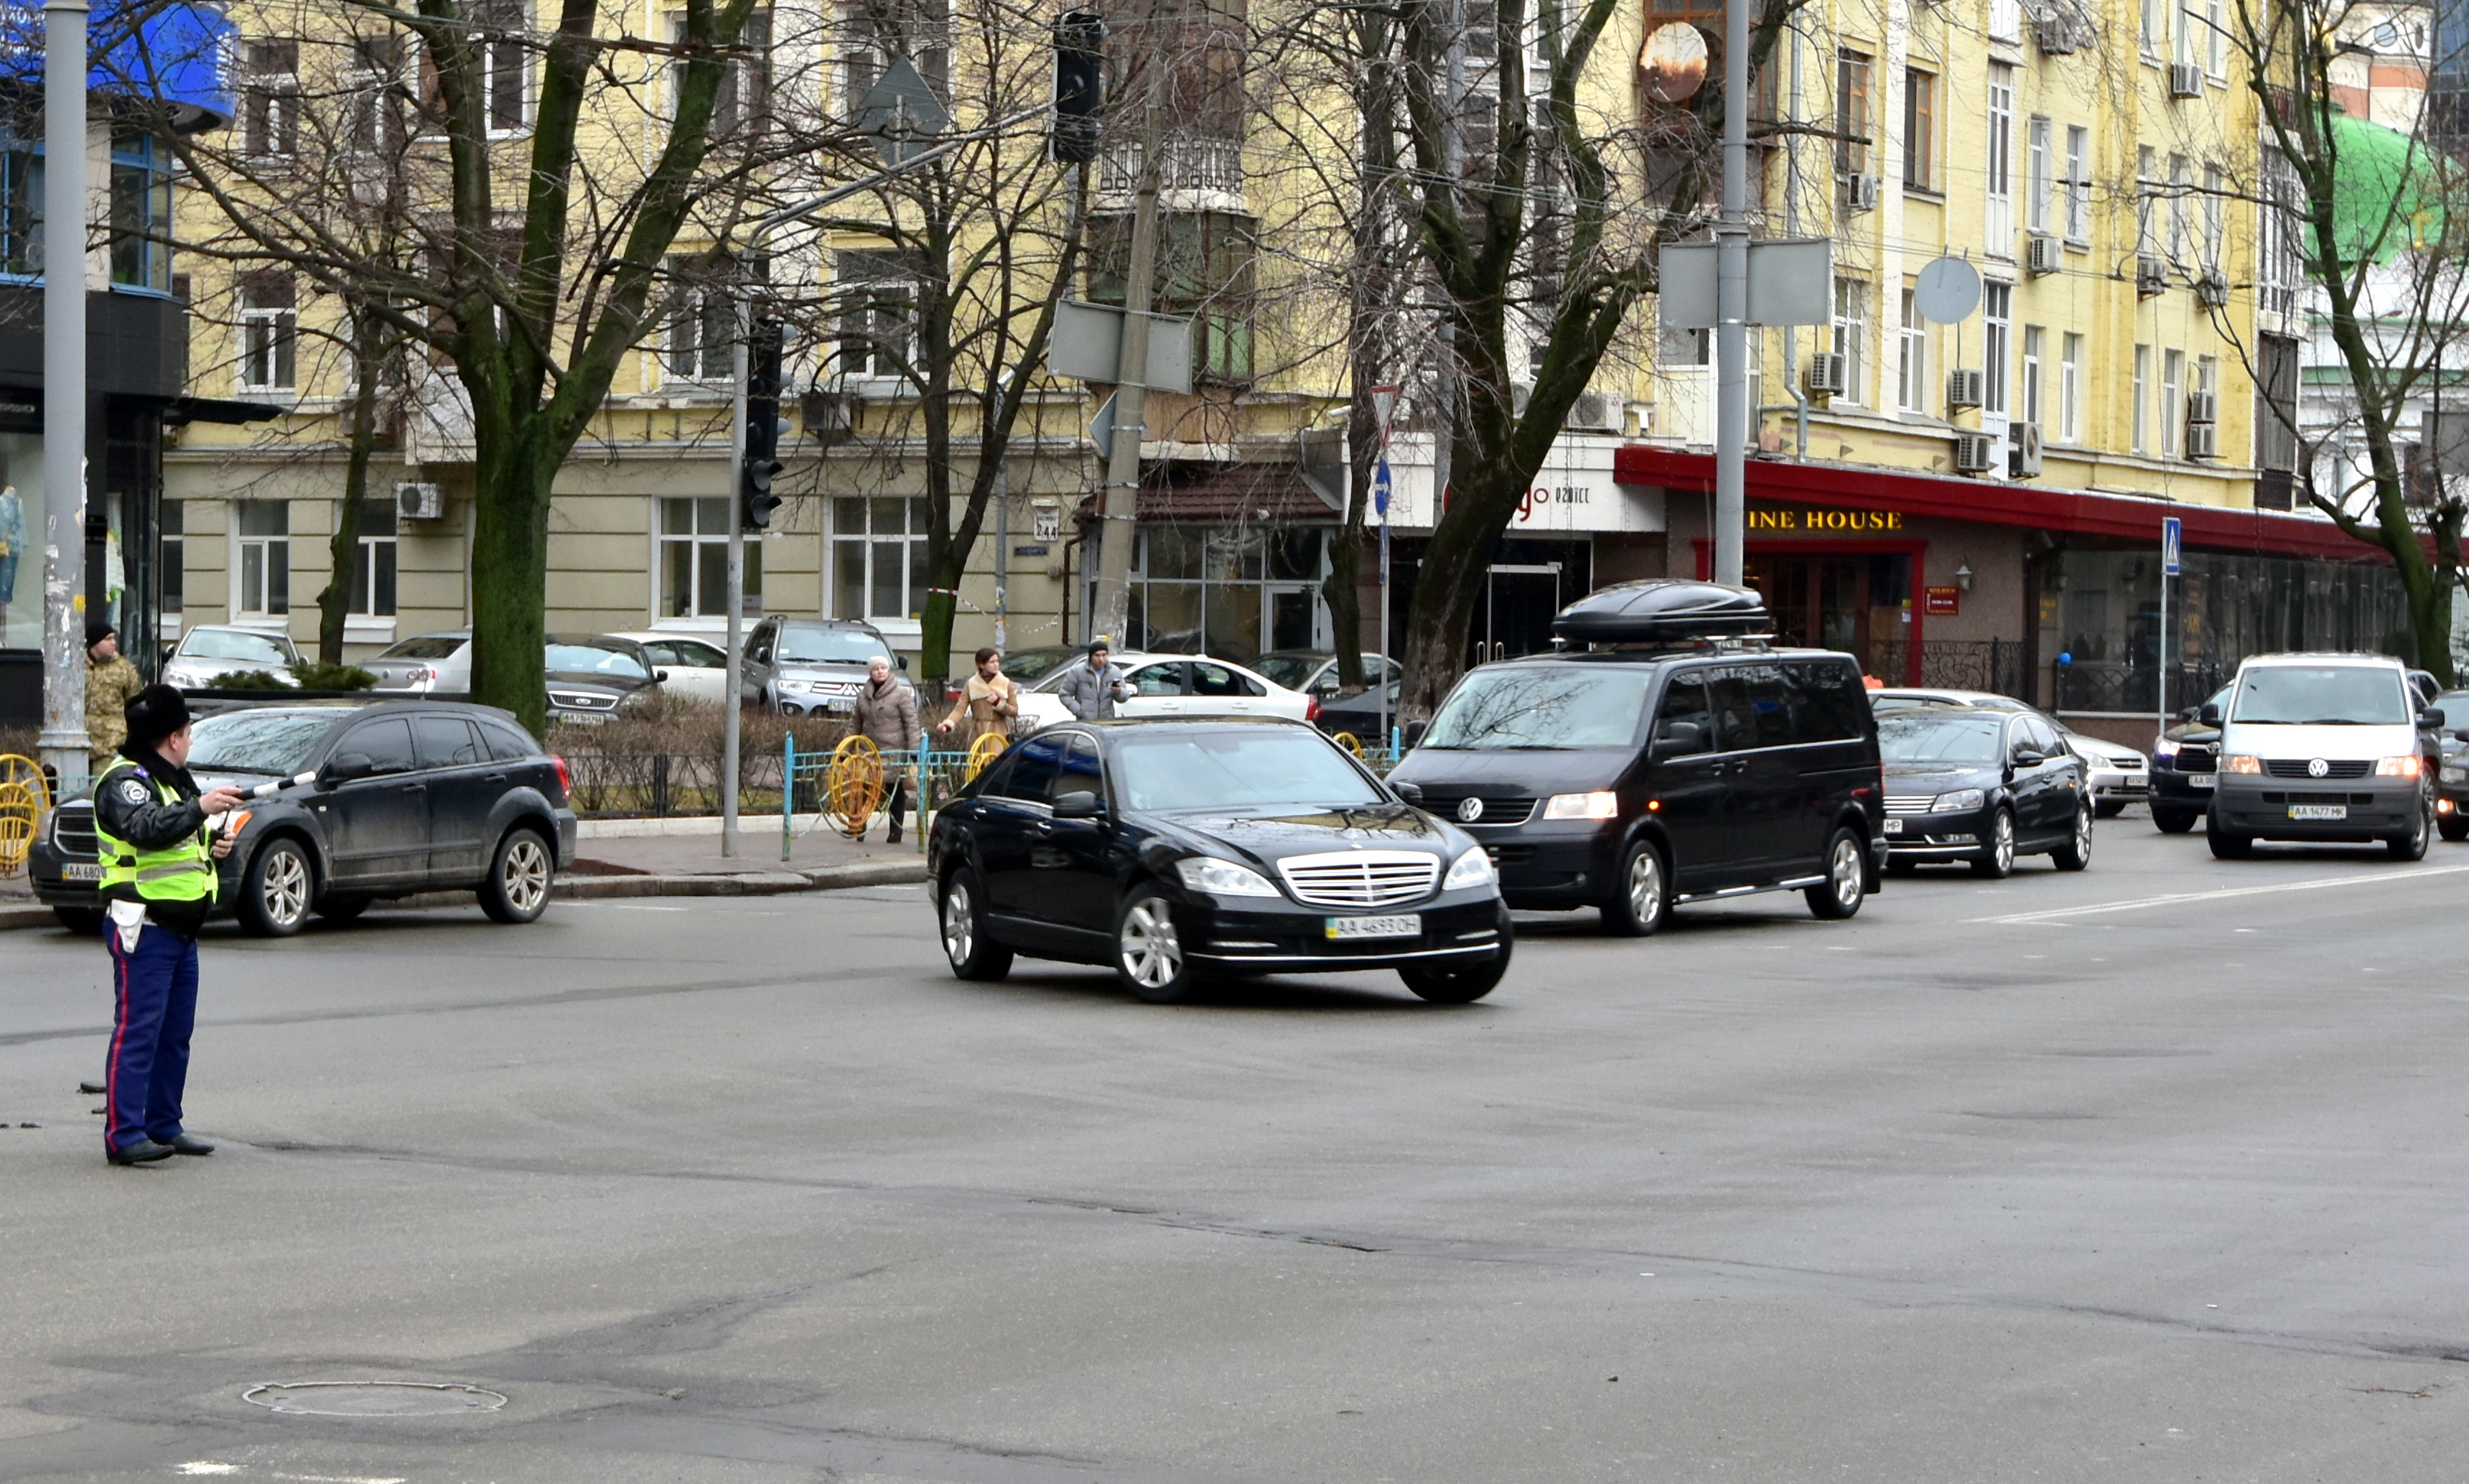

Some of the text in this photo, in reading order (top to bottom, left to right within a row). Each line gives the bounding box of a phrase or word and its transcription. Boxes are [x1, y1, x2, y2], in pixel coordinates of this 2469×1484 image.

[1748, 510, 1902, 529] INE HOUSE
[2295, 807, 2307, 816] AA
[2310, 807, 2329, 816] 1477
[69, 865, 100, 878] AA 680
[1338, 920, 1359, 935] AA
[1396, 916, 1417, 933] OH
